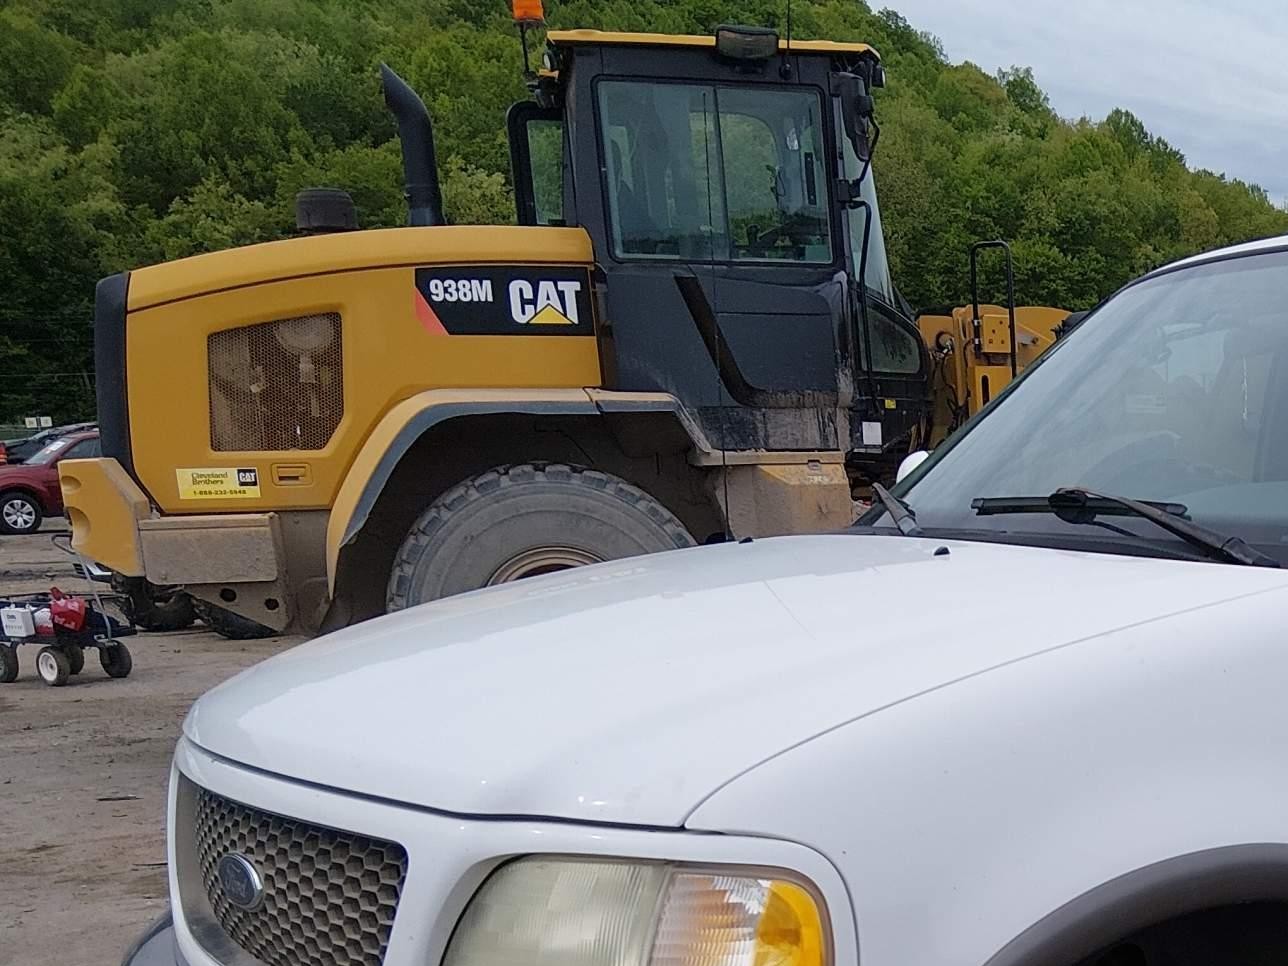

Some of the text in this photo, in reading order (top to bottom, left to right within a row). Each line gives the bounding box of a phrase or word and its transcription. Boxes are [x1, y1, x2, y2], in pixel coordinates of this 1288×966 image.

[429, 279, 493, 302] 938M
[509, 280, 580, 324] CAT
[239, 472, 255, 482] CAT
